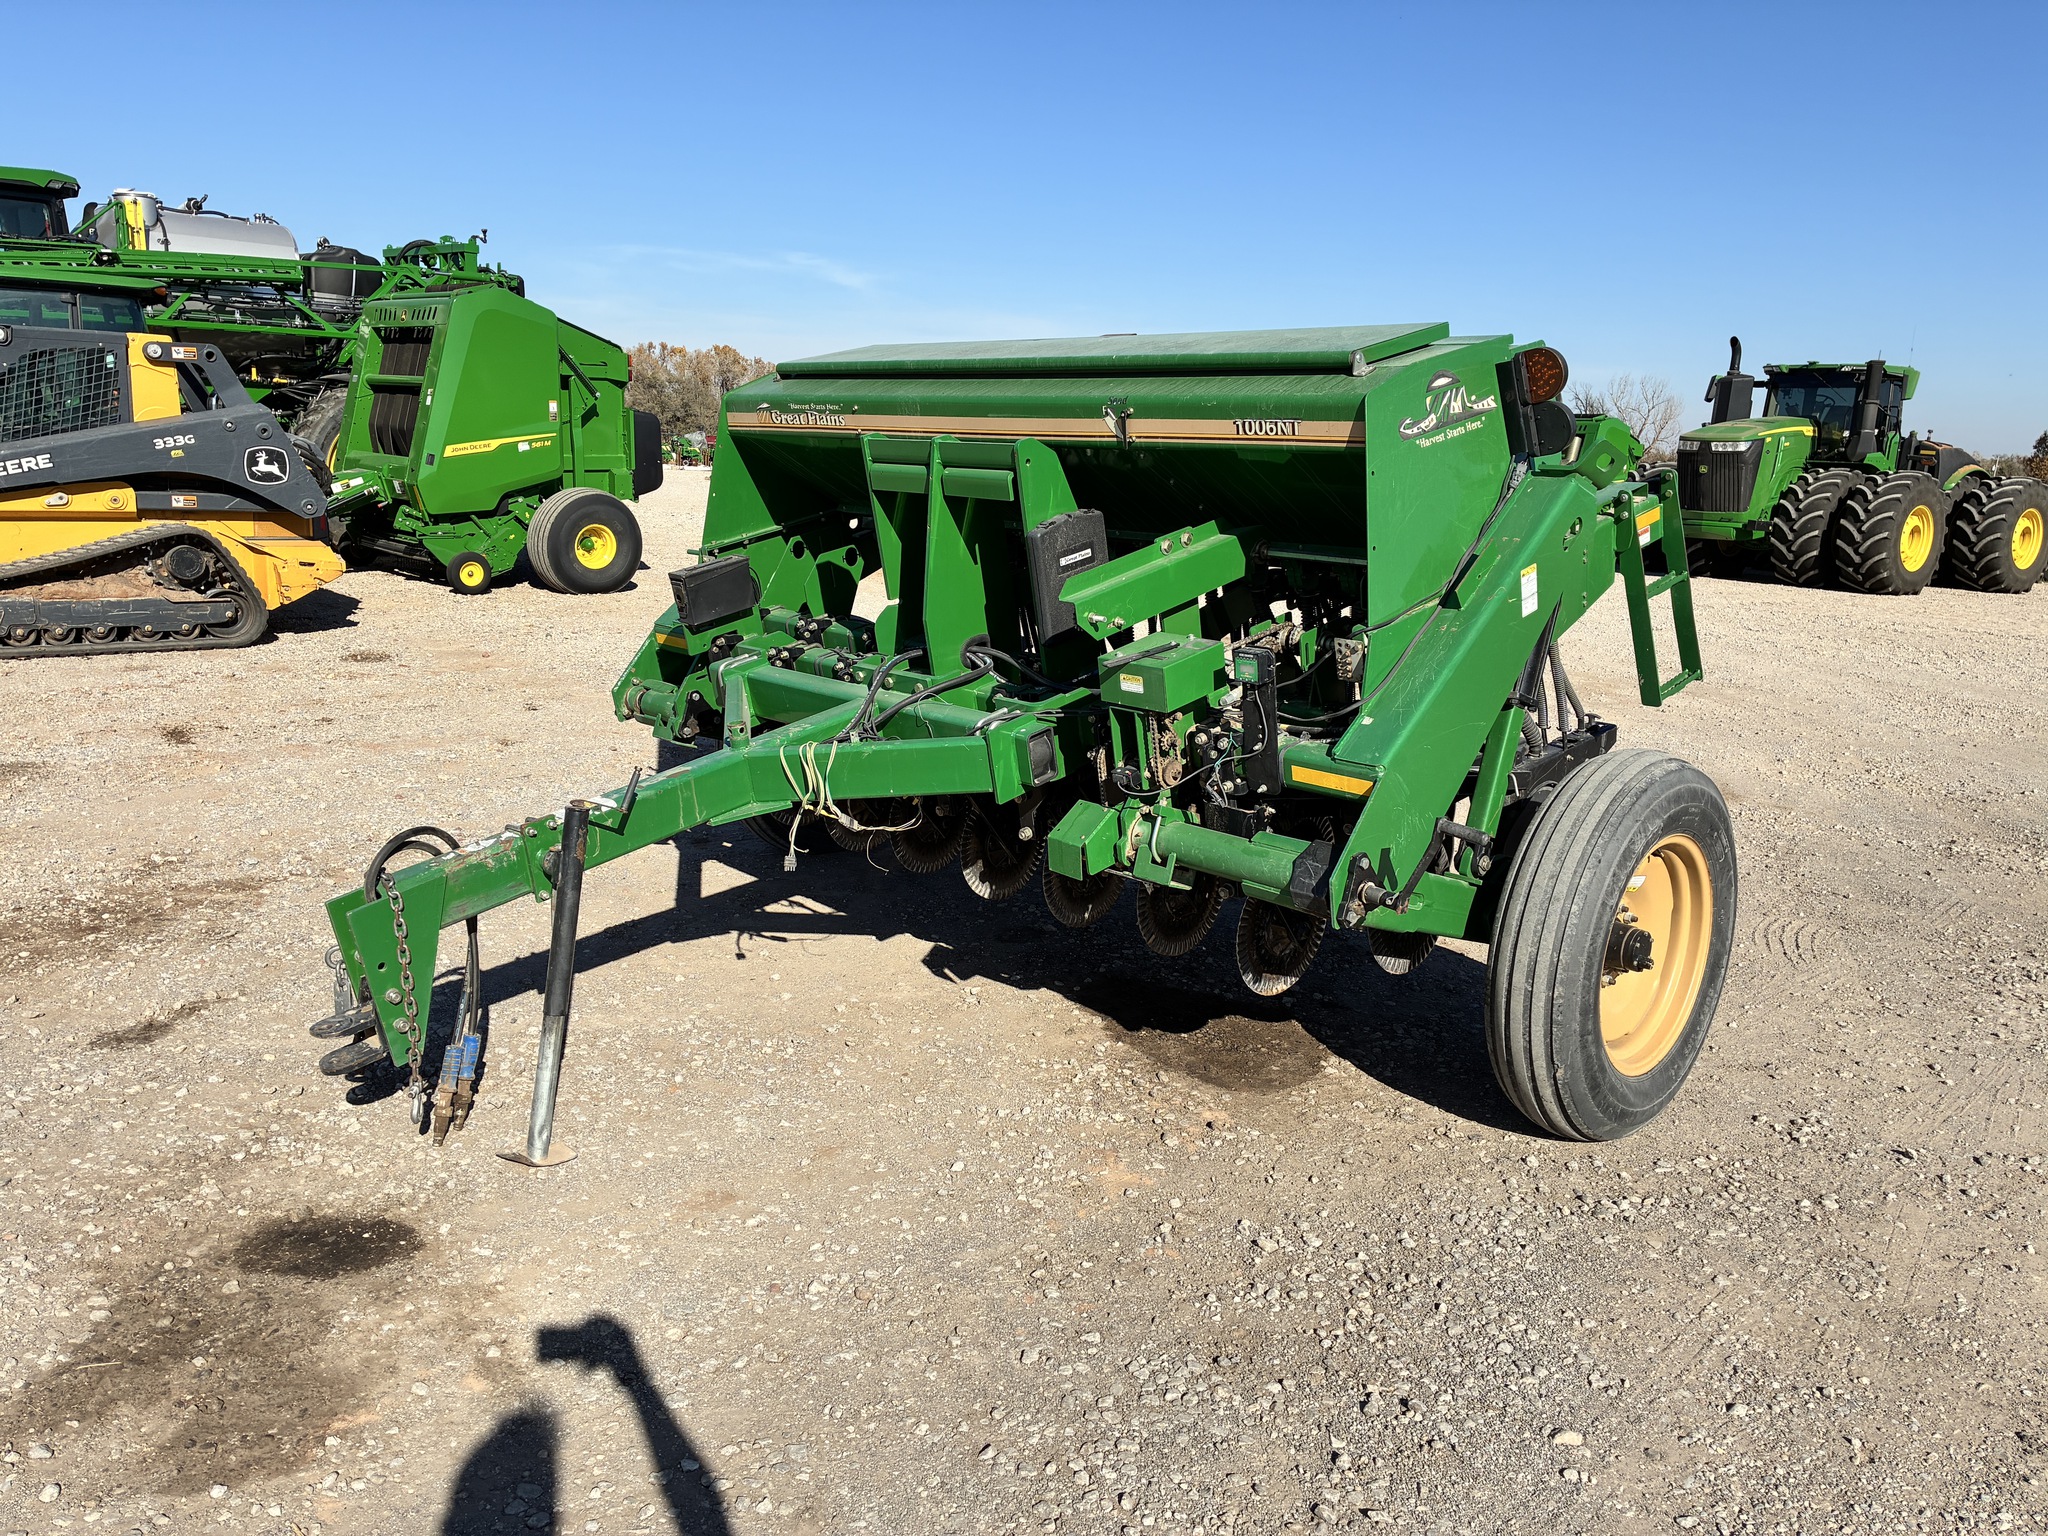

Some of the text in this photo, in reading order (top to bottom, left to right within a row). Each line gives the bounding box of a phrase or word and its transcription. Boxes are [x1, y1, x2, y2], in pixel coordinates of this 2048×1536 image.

[1107, 395, 1129, 405] Seed
[806, 410, 846, 426] Plains
[1233, 418, 1302, 436] 1006NT
[1416, 416, 1486, 448] "Harvest Starts Here."
[153, 434, 196, 450] 333G
[469, 443, 492, 451] DEERE
